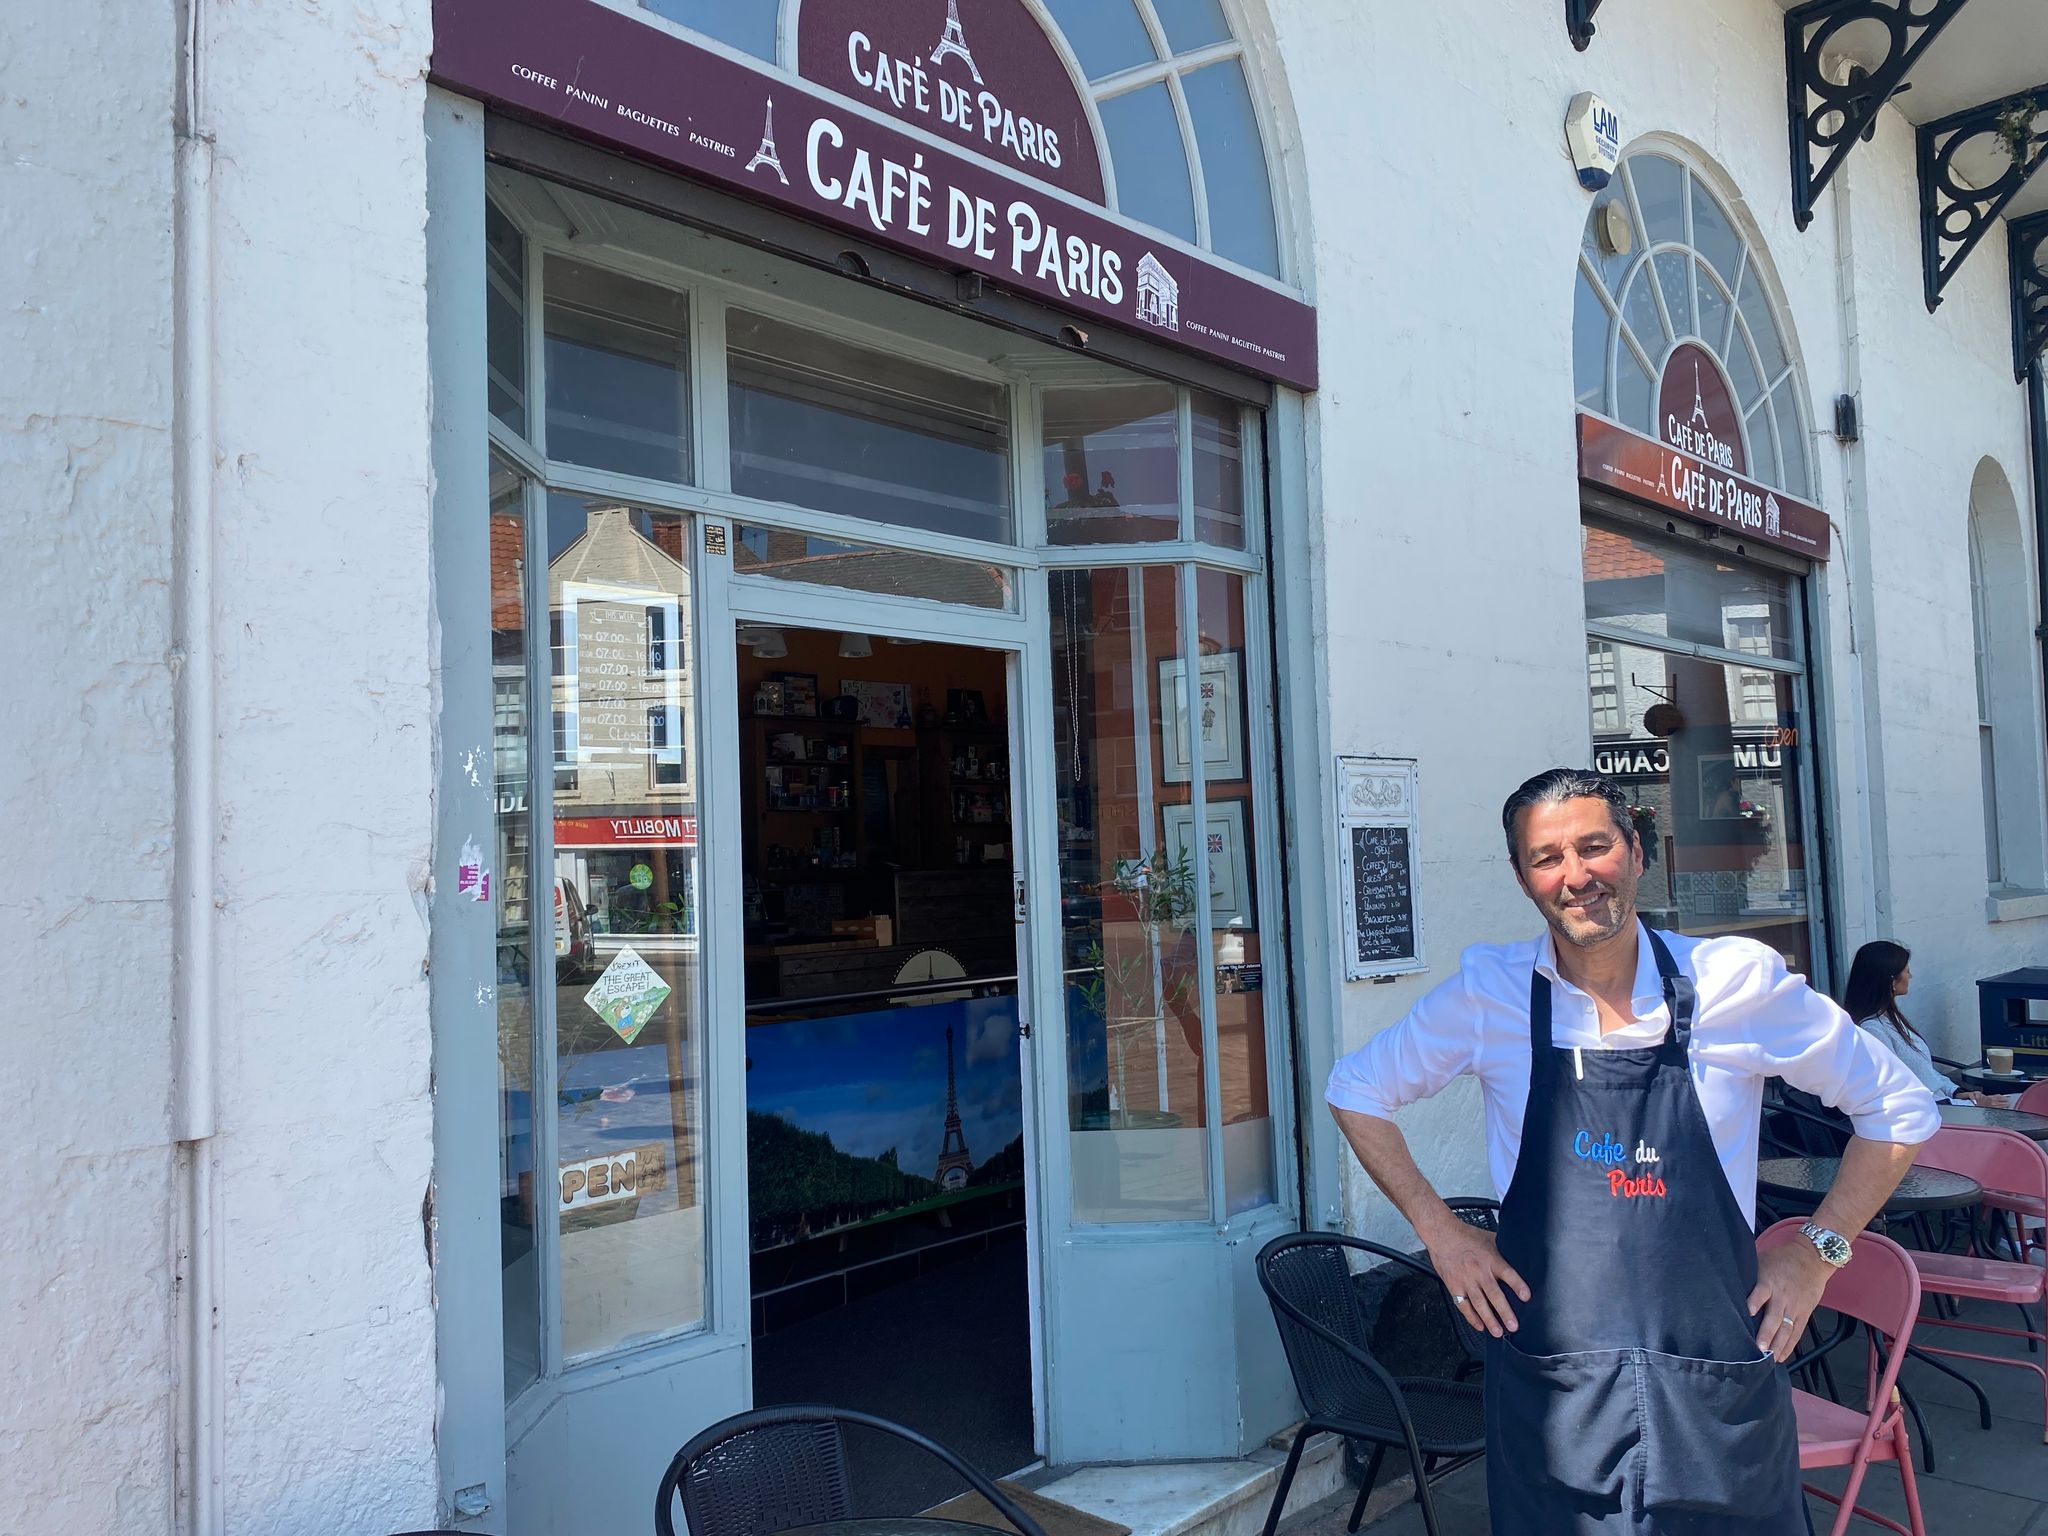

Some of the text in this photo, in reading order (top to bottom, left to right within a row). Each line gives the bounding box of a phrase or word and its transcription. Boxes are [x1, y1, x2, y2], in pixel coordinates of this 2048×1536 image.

[511, 64, 736, 158] COFFEE PANINI BAGUETTES PASTRIES
[848, 30, 1062, 169] CAFÉ DE PARIS
[1593, 107, 1618, 145] LAM
[806, 117, 1125, 305] CAFÉ DE PARIS
[1186, 320, 1286, 362] COFFEE PANINI BAGUETTES PASTRIES
[1694, 432, 1706, 455] DE
[1706, 430, 1733, 468] PARIS
[1671, 456, 1706, 511] CAFÉ
[1709, 479, 1724, 516] DE
[1726, 478, 1762, 529] PARIS
[603, 971, 652, 985] THE GREAT
[1573, 1130, 1660, 1165] Cafe du
[558, 1159, 636, 1204] PEN
[1606, 1169, 1667, 1199] Paris
